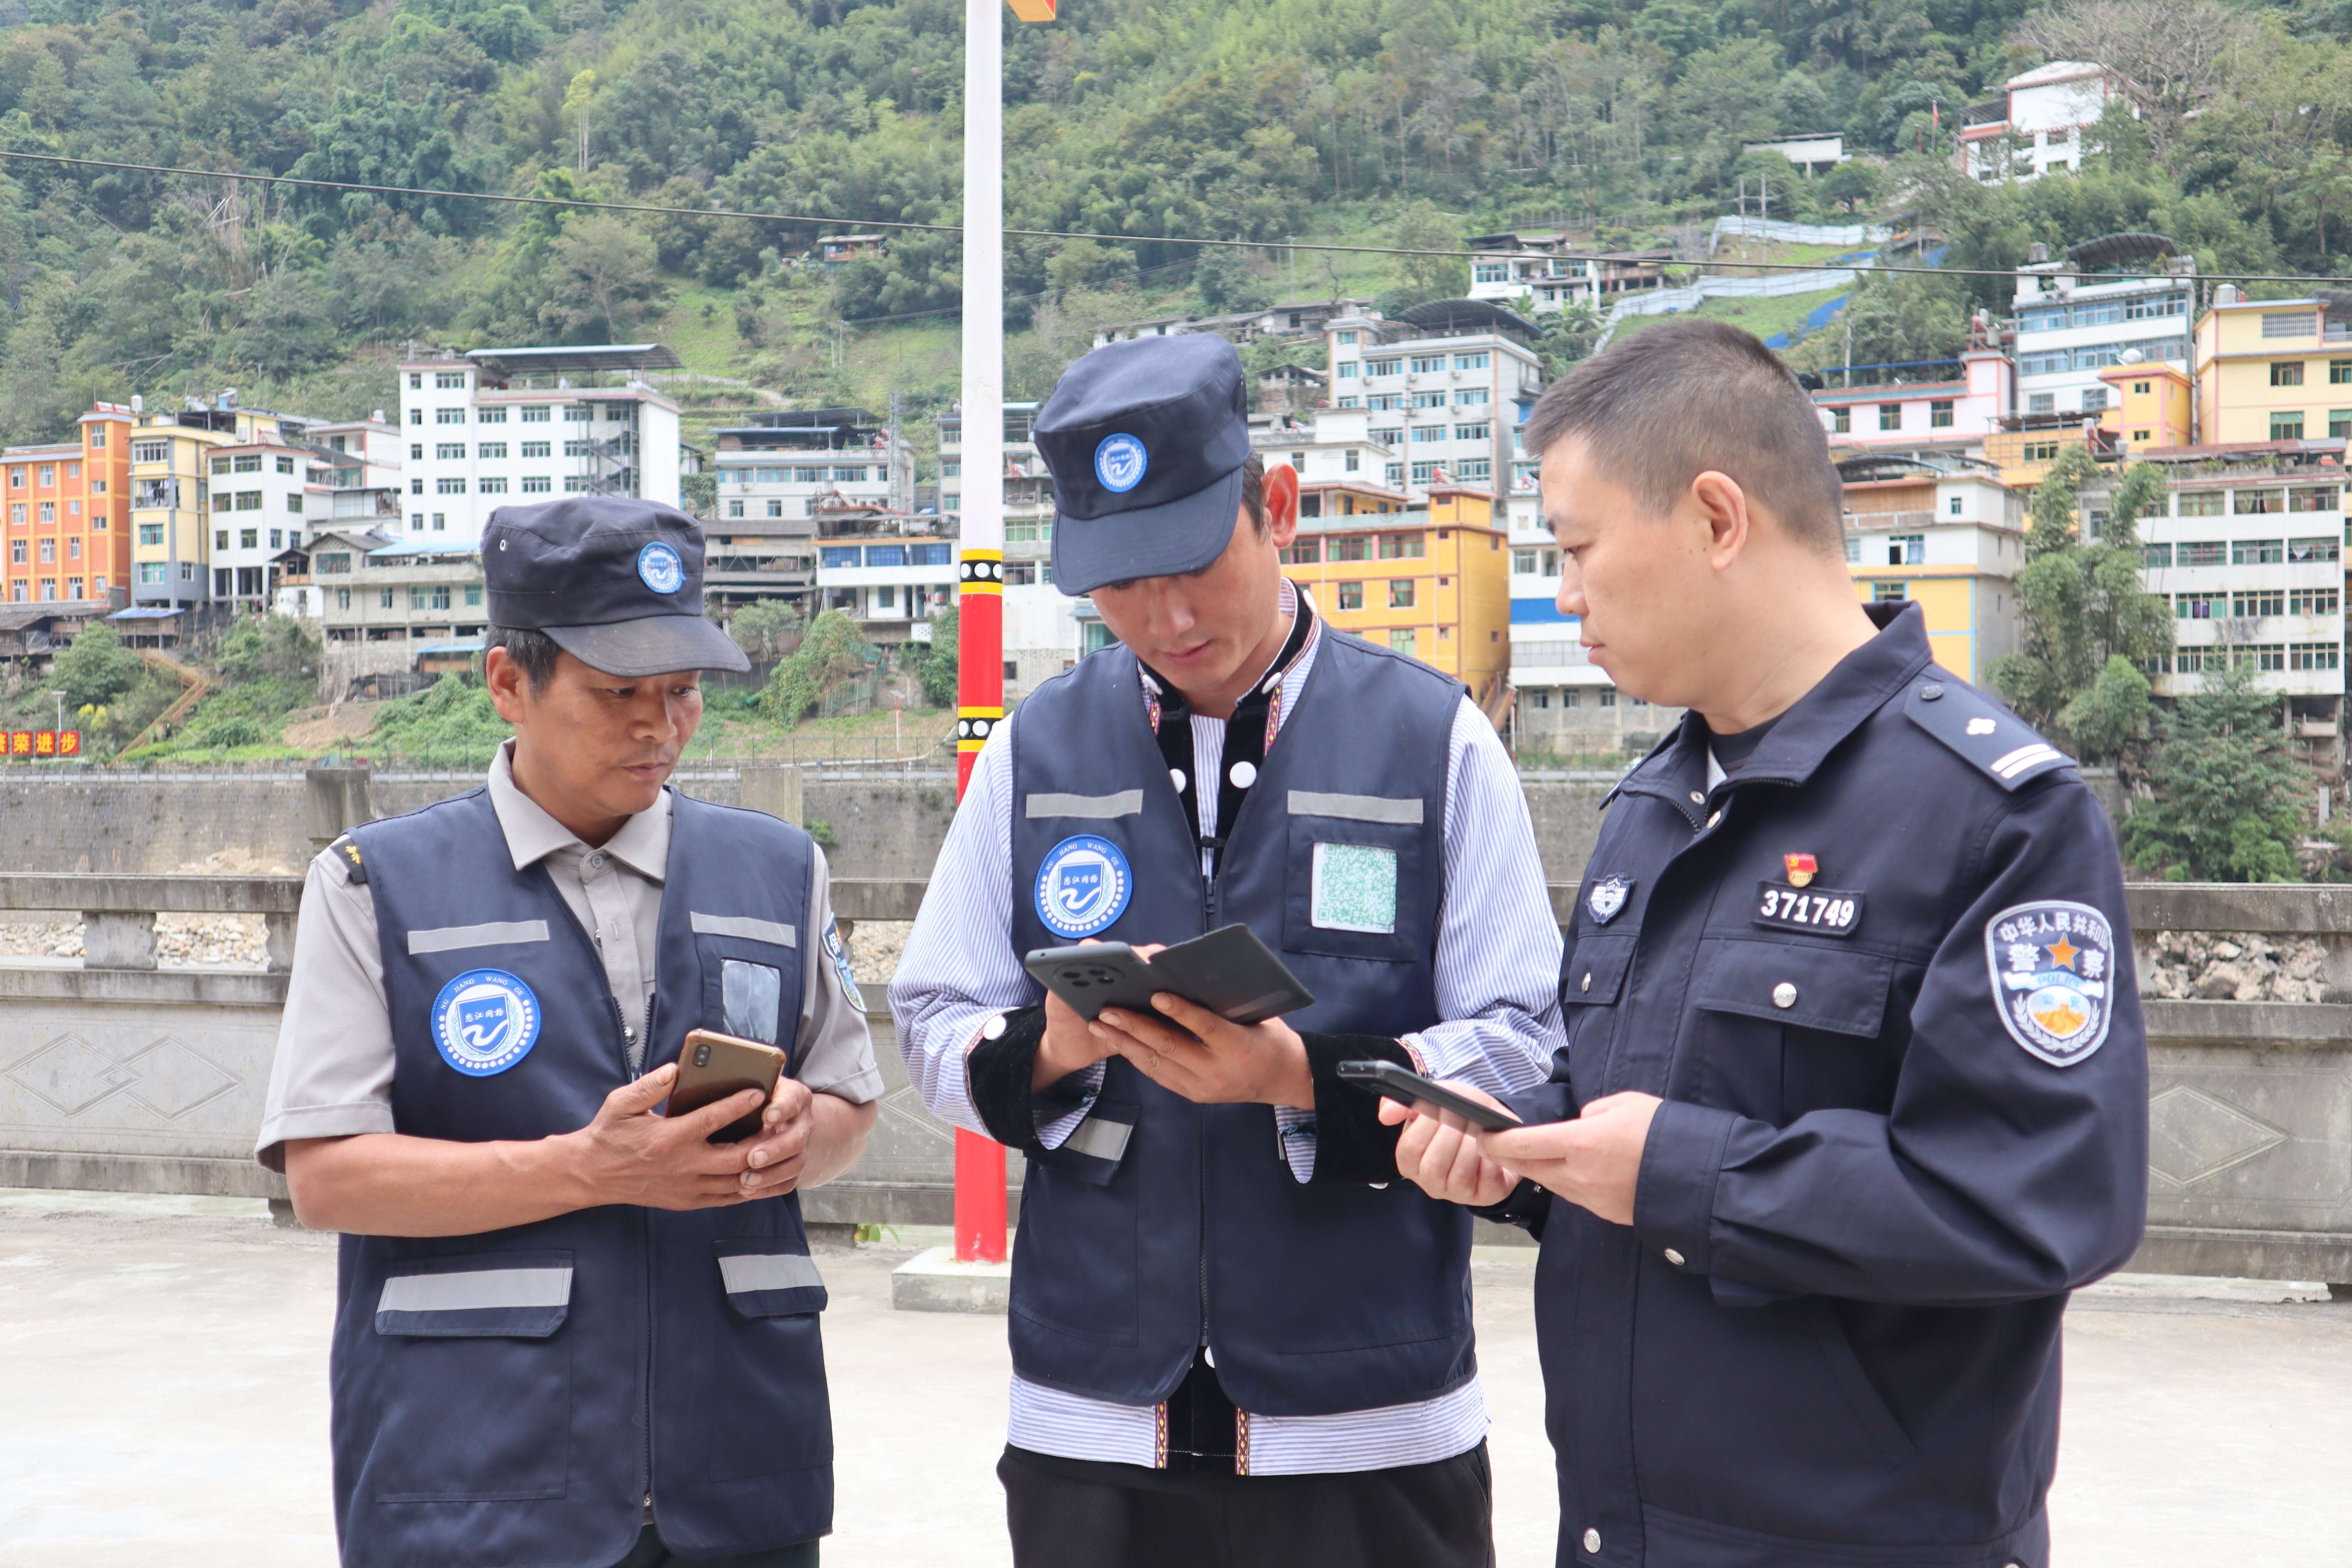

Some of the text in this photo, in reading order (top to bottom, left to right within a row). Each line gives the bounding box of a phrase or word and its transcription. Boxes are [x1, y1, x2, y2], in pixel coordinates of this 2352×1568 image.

[1045, 842, 1119, 871] NU JIANG WANG GE
[1063, 874, 1098, 886] 怒江网格
[1760, 890, 1855, 927] 371749
[2000, 911, 2109, 951] 中华人民共和国
[440, 976, 524, 1010] NU JIANG WANG GE
[465, 1008, 503, 1023] 怒江网格
